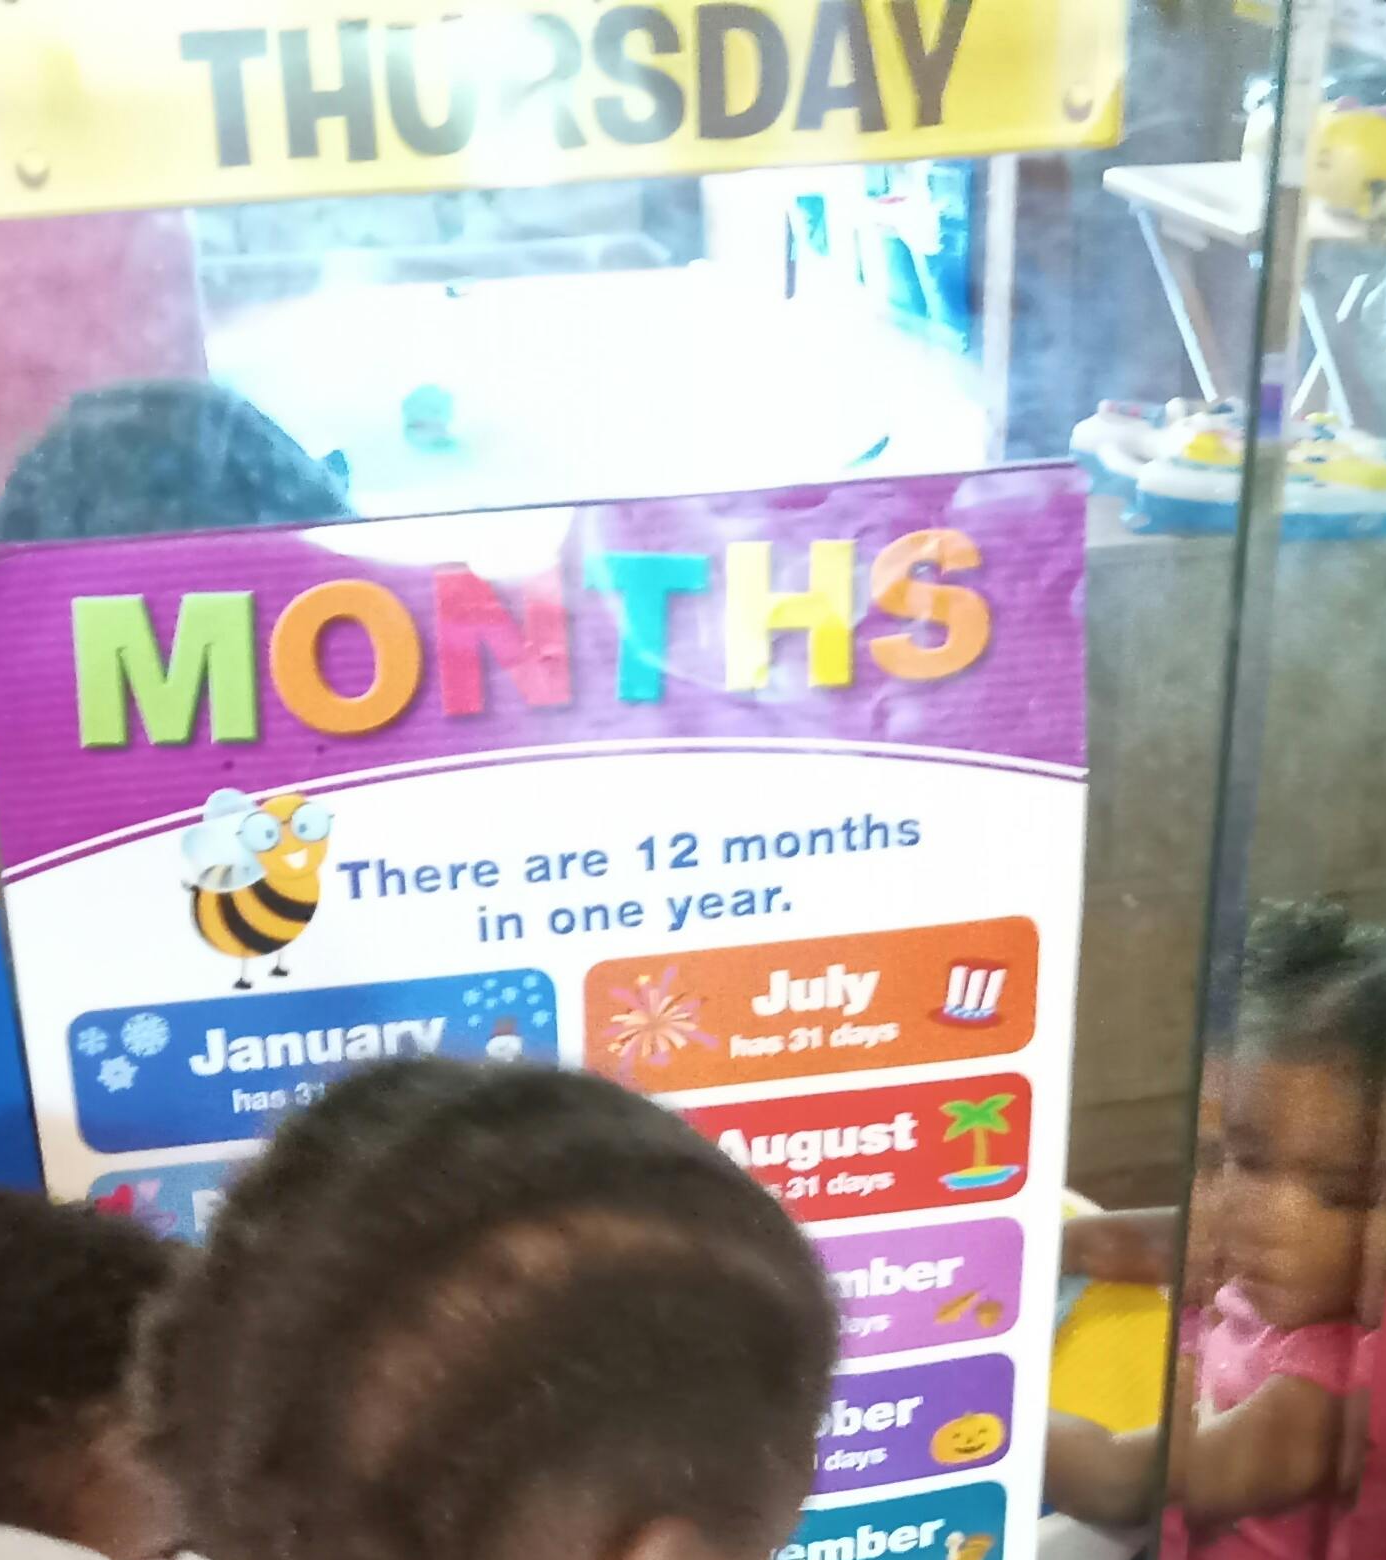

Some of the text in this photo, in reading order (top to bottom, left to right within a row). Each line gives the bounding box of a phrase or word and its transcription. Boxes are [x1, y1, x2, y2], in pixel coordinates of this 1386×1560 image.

[179, 0, 971, 168] THURSDAY
[71, 527, 992, 750] MONTHS
[337, 812, 922, 901] There are 12 months
[477, 881, 794, 943] in one year.
[751, 963, 881, 1017] July
[189, 1015, 448, 1077] January
[730, 1021, 901, 1059] has 31 days
[717, 1111, 919, 1172] August
[785, 1174, 821, 1199] 31
[825, 1171, 896, 1197] days
[823, 1447, 889, 1472] days
